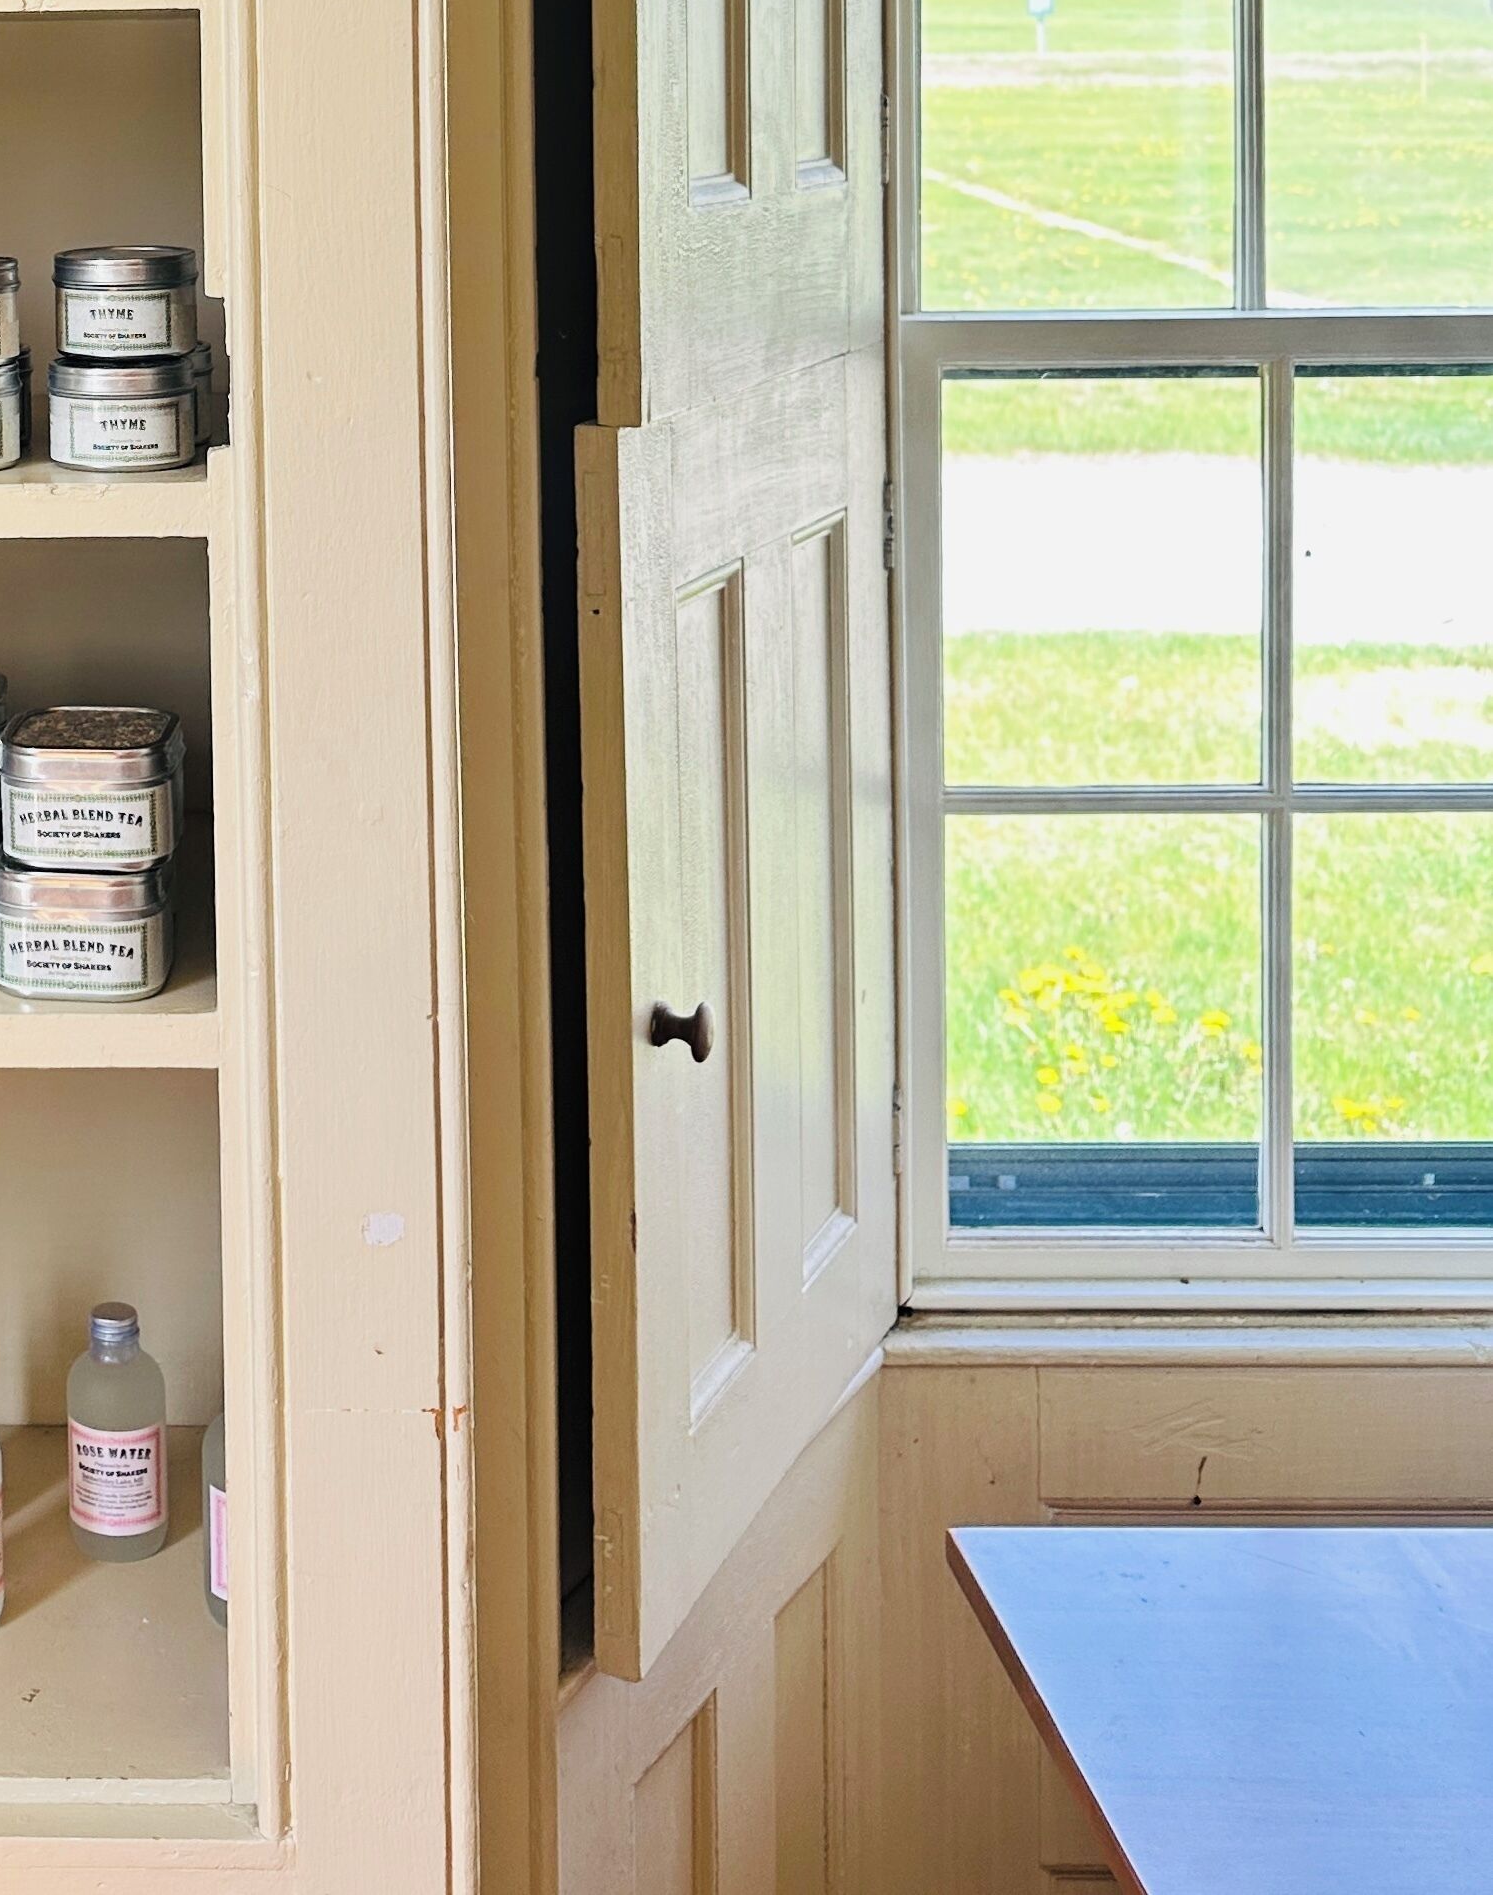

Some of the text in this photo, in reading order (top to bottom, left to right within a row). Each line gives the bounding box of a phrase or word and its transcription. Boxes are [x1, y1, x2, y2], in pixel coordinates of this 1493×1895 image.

[89, 309, 134, 321] THYME
[99, 419, 146, 431] THYME
[19, 809, 143, 827] HERBAL BLEND TEA
[37, 830, 70, 838] SOCIETY
[83, 830, 120, 839] SHAKERS
[9, 940, 134, 960] HERBAL BLEND TEA
[76, 1444, 151, 1460] ROSE WATER
